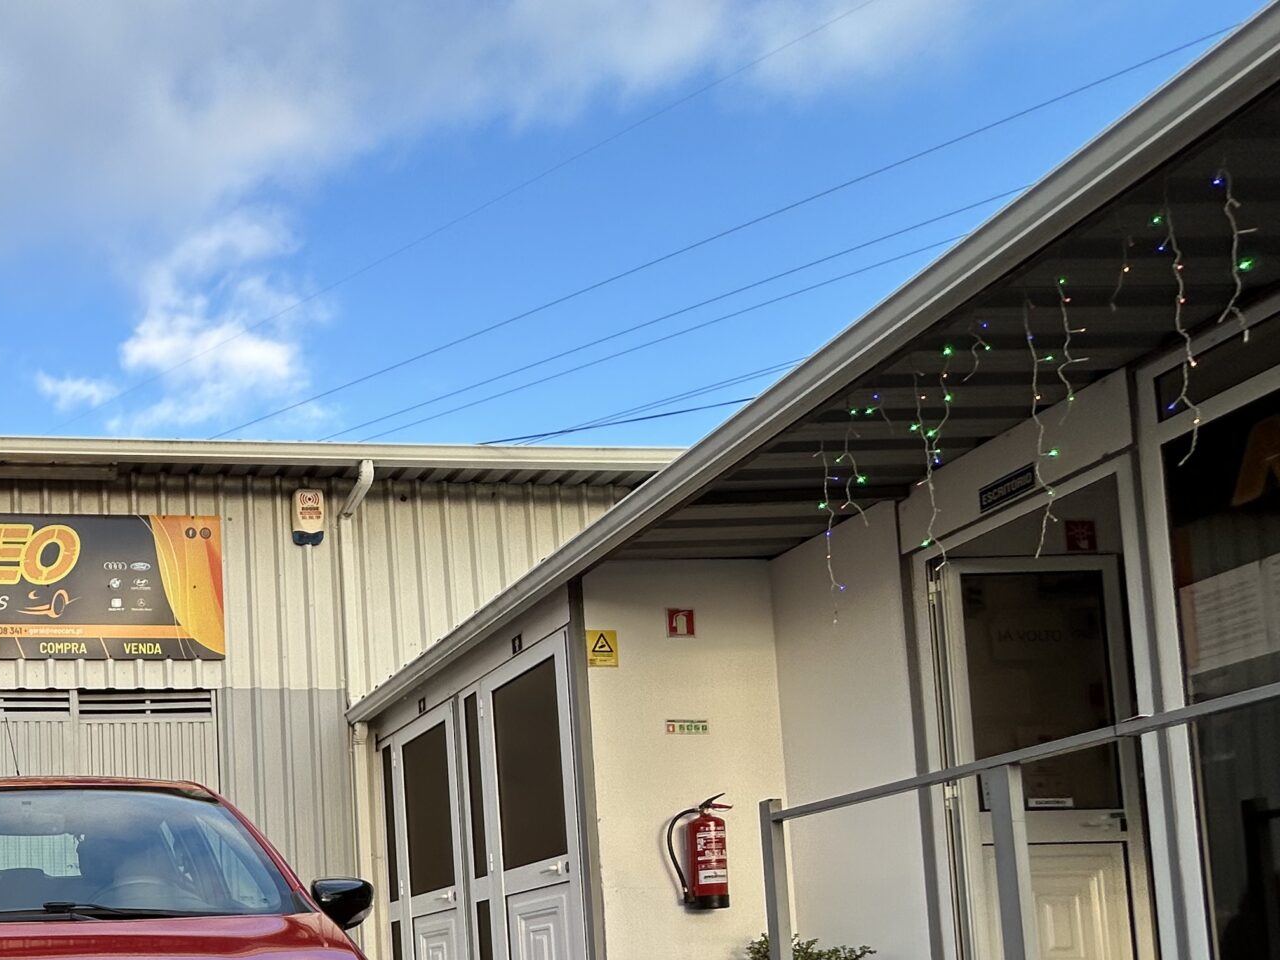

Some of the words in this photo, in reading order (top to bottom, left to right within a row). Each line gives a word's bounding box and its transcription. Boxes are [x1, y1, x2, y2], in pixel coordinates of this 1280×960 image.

[10, 626, 22, 635] 341
[39, 642, 87, 654] COMPRA
[123, 643, 162, 655] VENDA
